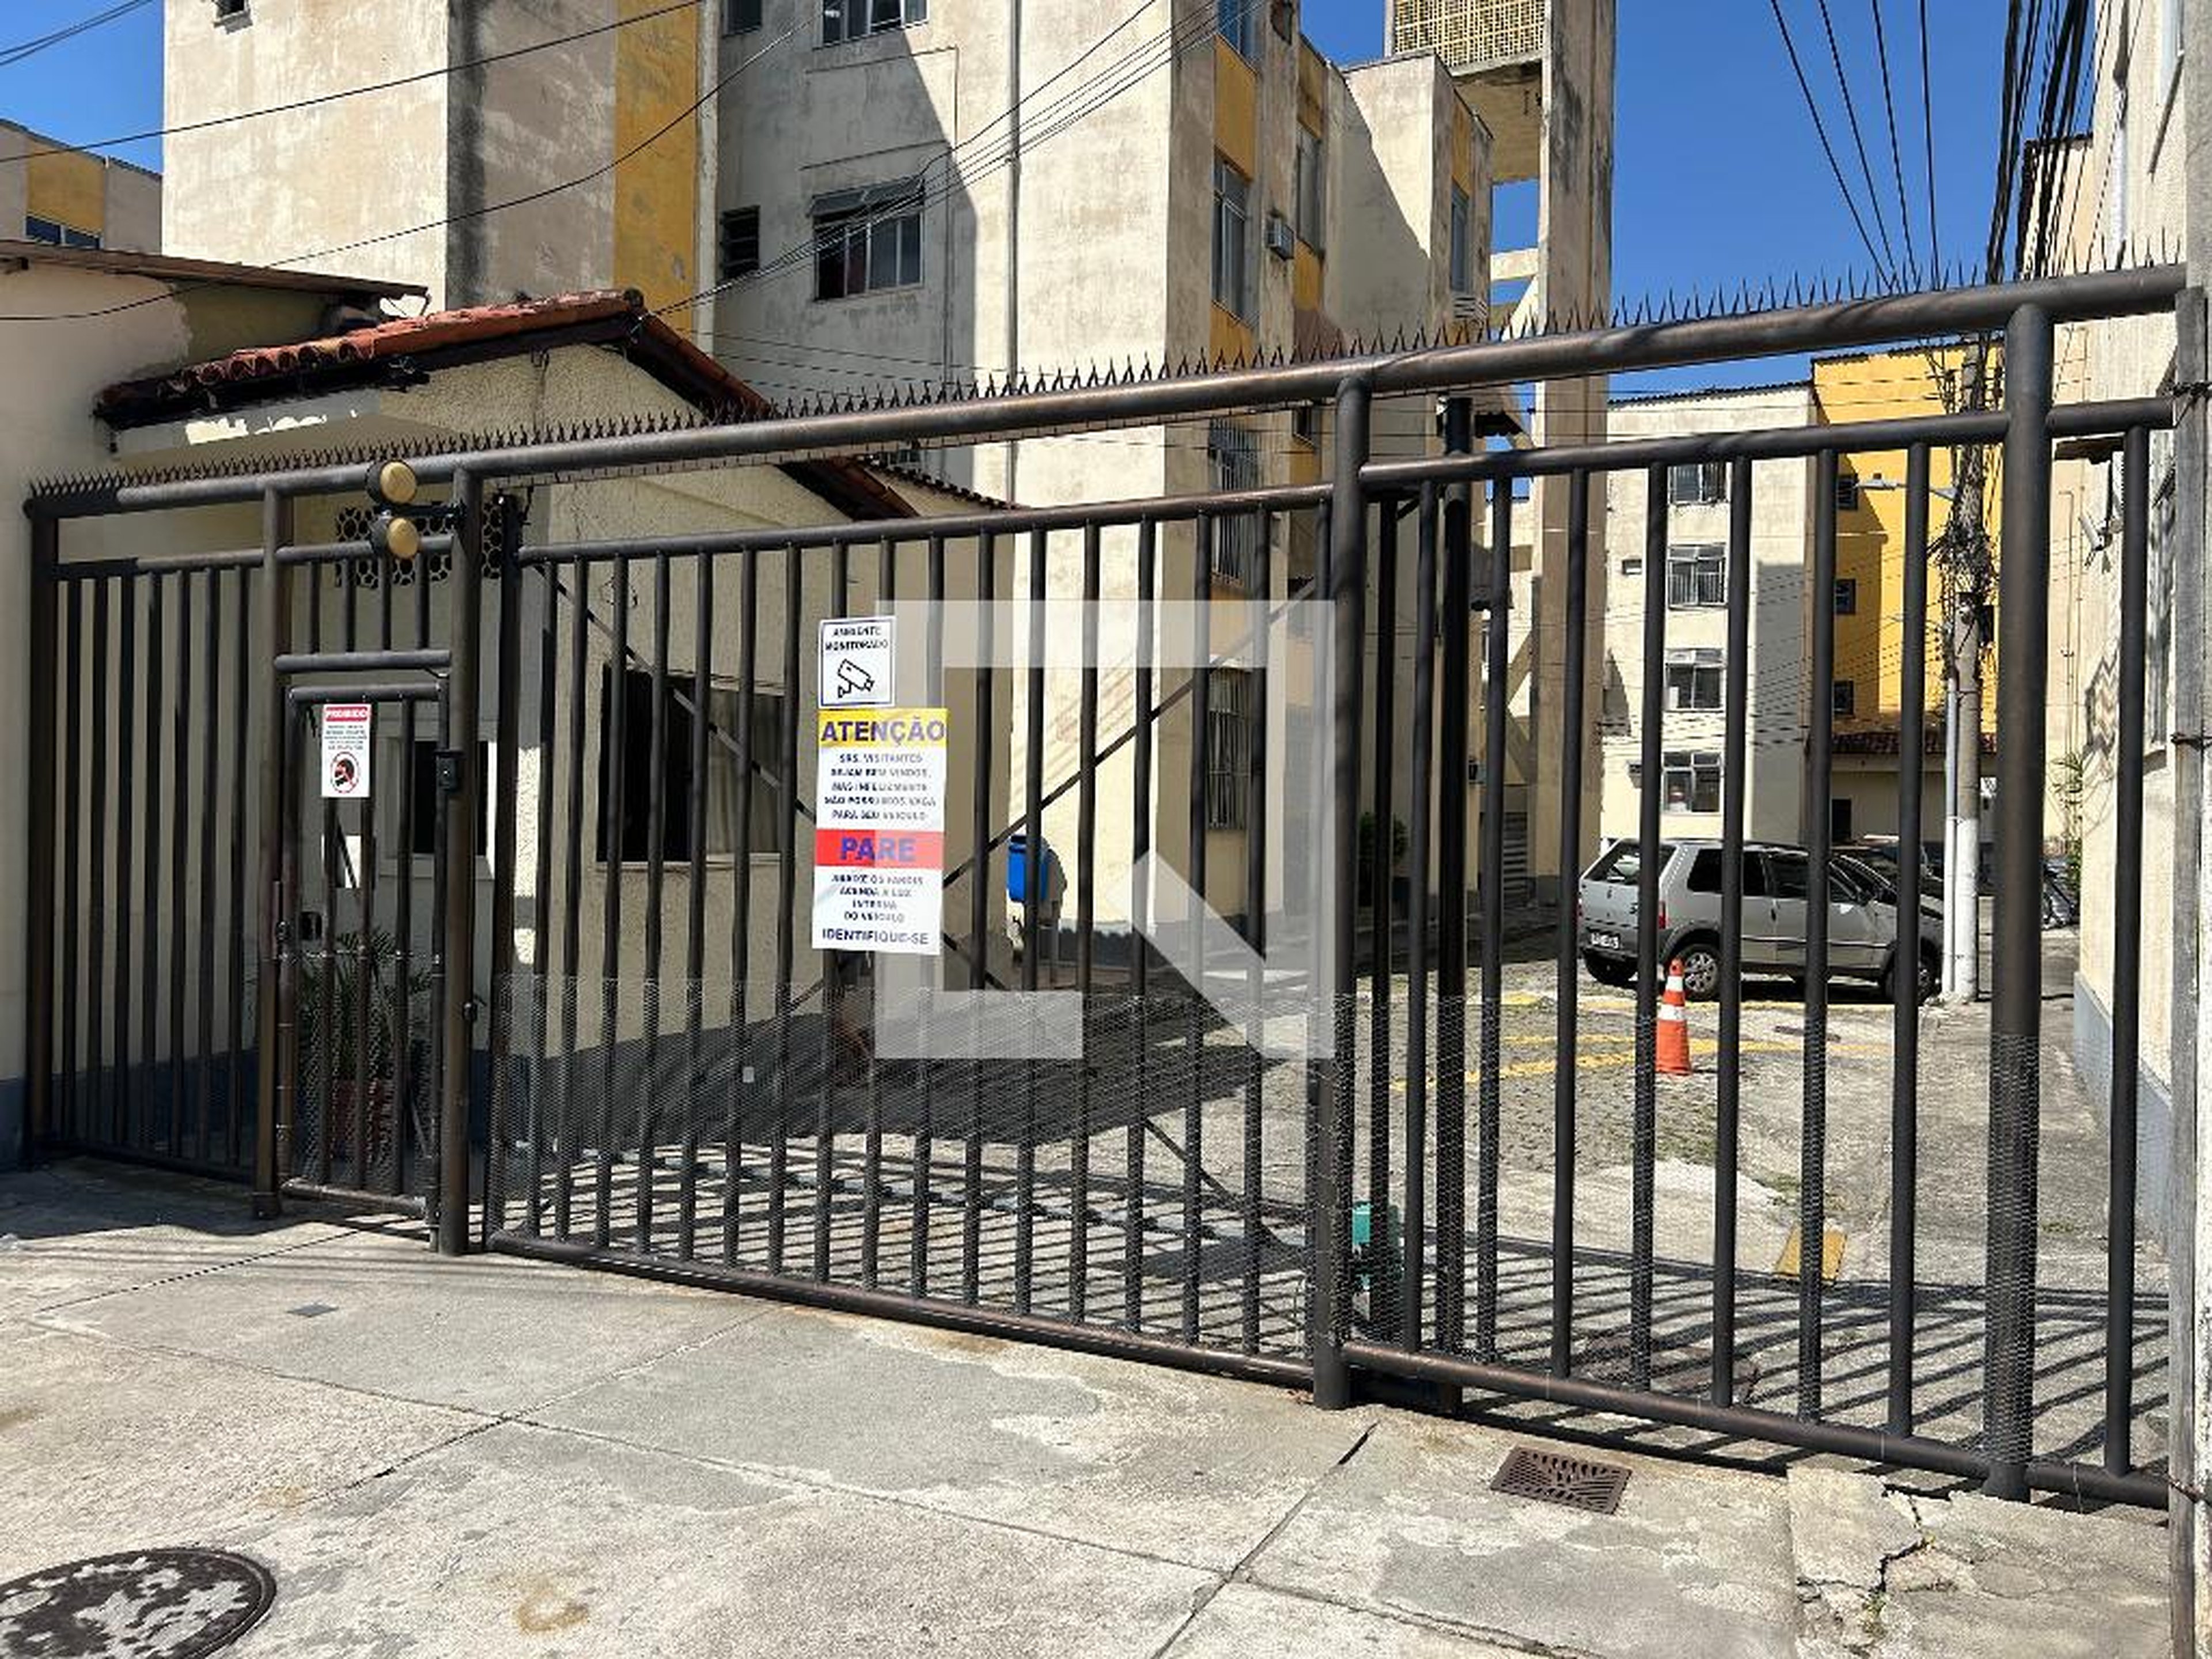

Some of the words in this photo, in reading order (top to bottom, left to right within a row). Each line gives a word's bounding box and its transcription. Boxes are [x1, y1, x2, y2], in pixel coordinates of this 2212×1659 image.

[821, 715, 944, 745] ATENÇÃO
[840, 838, 916, 862] PARE
[822, 928, 929, 945] IDENTIFIQUE-SE
